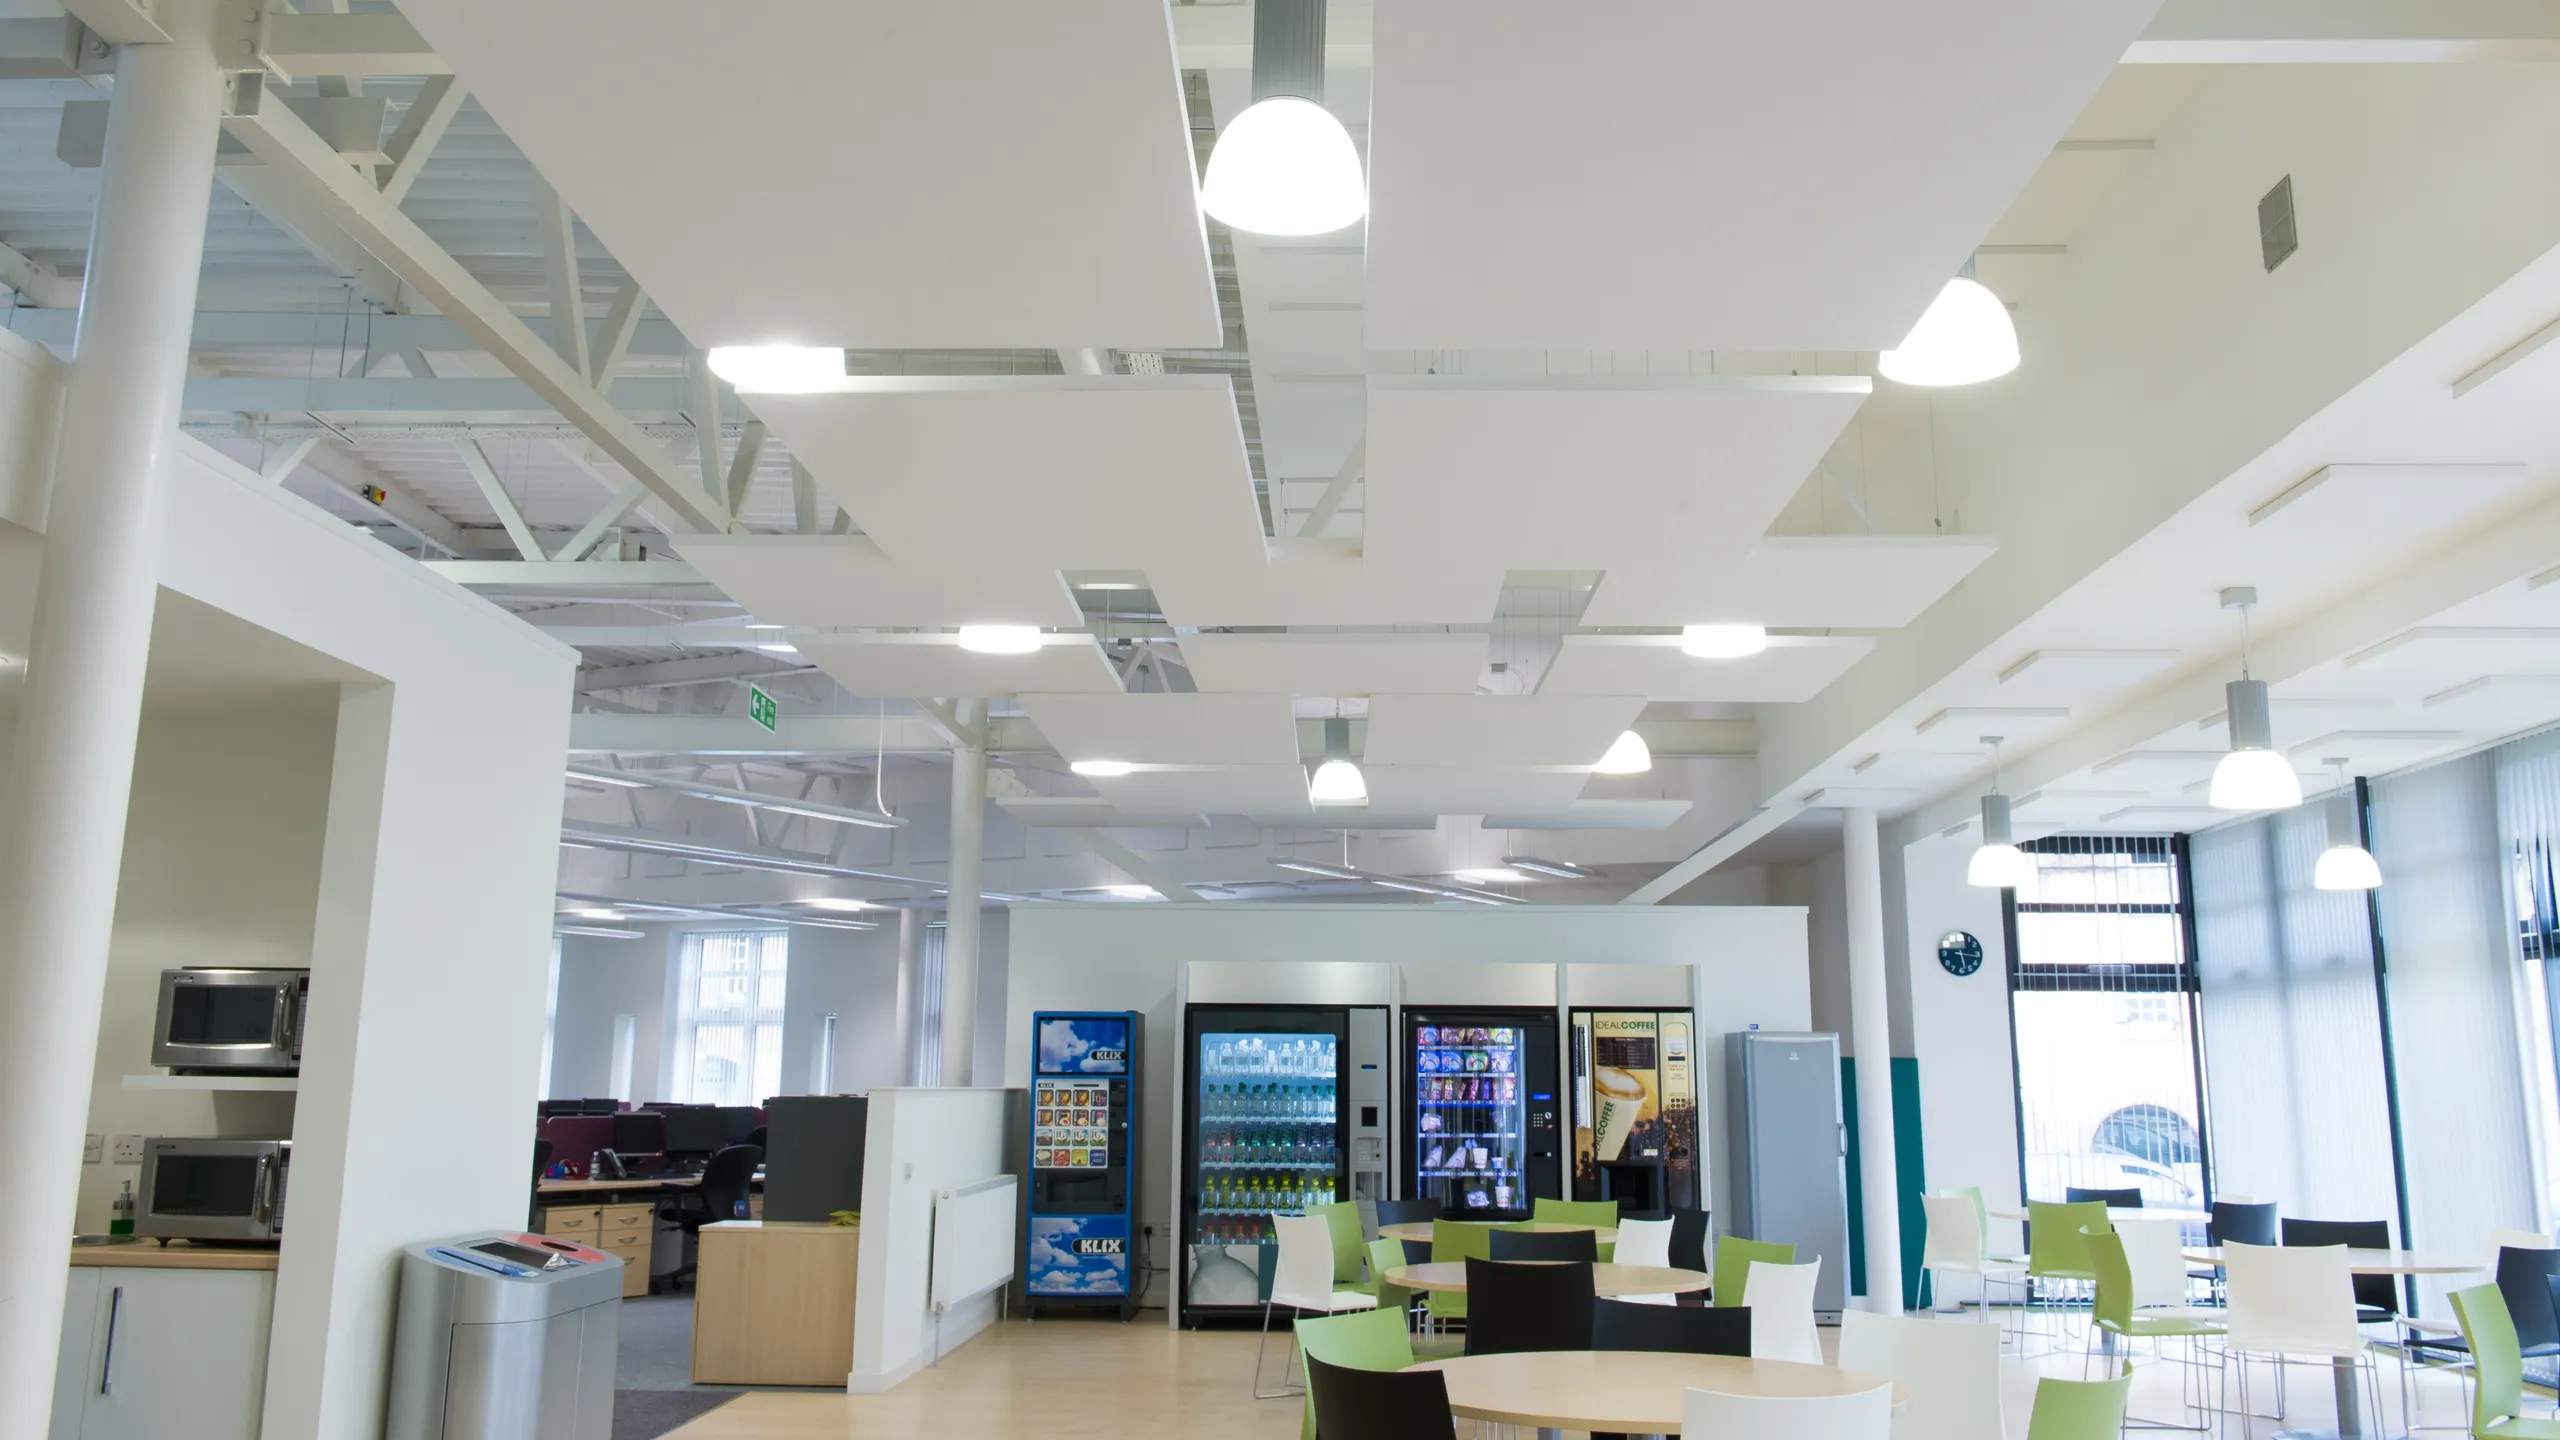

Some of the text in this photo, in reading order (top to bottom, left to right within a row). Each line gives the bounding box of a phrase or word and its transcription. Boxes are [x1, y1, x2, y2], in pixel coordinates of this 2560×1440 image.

[1595, 1020, 1655, 1030] IDEALCOFFEE
[1096, 1051, 1122, 1060] KLIX
[1080, 1239, 1121, 1253] KLIX
